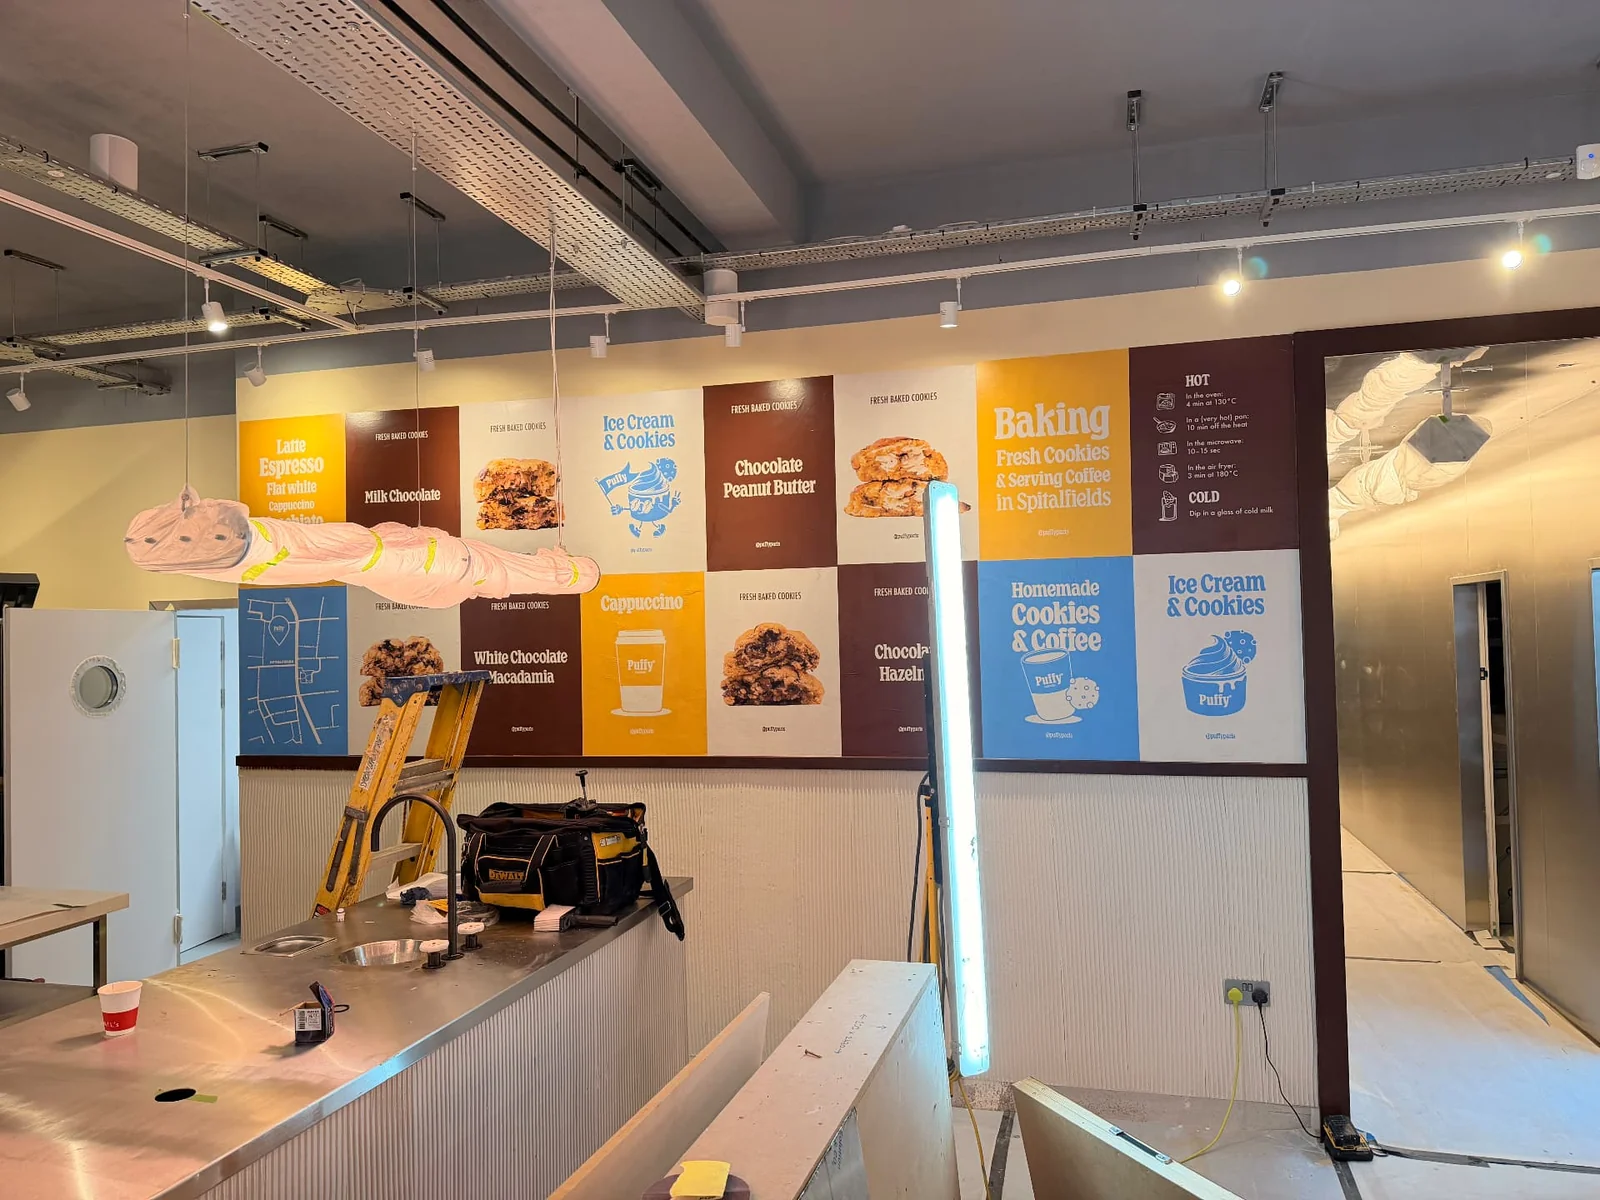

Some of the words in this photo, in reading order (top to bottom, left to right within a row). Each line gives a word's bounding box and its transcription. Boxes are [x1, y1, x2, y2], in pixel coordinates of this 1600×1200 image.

[1185, 373, 1211, 387] HOT
[870, 396, 889, 405] FRESH
[890, 394, 910, 404] BAKED
[911, 392, 938, 402] COOKIES
[1193, 392, 1204, 400] the
[731, 404, 750, 414] FRESH
[751, 402, 770, 413] BAKED
[772, 400, 798, 411] COOKIES
[490, 424, 506, 433] FRESH
[507, 423, 523, 432] BAKED
[524, 421, 547, 431] COOKIES
[603, 415, 625, 431] Ice
[627, 414, 675, 430] Cream
[994, 402, 1111, 440] Baking
[1210, 422, 1220, 430] off
[1233, 421, 1248, 429] heat
[375, 432, 390, 441] FRESH
[391, 431, 407, 440] BAKED
[407, 430, 429, 439] COOKIES
[604, 433, 614, 450] &
[617, 431, 676, 450] Cookies
[1206, 438, 1244, 446] microwave:
[276, 438, 307, 455] Latte
[996, 447, 1041, 467] Fresh
[1044, 444, 1110, 464] Cookies
[259, 456, 325, 480] Espresso
[735, 457, 803, 477] Chocolate
[996, 473, 1006, 488] &
[1008, 471, 1063, 488] Serving
[1065, 467, 1111, 485] Coffee
[266, 481, 286, 496] Flat
[287, 479, 317, 495] white
[723, 481, 772, 498] Peanut
[773, 479, 816, 496] Butter
[364, 490, 388, 504] Milk
[389, 488, 441, 503] Chocolate
[996, 493, 1014, 511] in
[1017, 488, 1112, 514] Spitalfields
[1188, 490, 1220, 504] COLD
[269, 499, 315, 513] Cappuccino
[1189, 510, 1201, 518] Dip
[1217, 509, 1234, 517] glass
[1244, 507, 1259, 515] cold
[1260, 506, 1274, 514] milk
[874, 588, 892, 597] FRESH
[893, 586, 913, 596] BAKED
[1011, 579, 1100, 598] Homemade
[1168, 575, 1197, 594] Ice
[1200, 573, 1266, 593] Cream
[600, 593, 684, 614] Cappuccino
[739, 593, 757, 601] FRESH
[758, 592, 777, 601] BAKED
[777, 591, 802, 600] COOKIES
[375, 602, 391, 610] FRESH
[491, 602, 508, 611] FRESH
[509, 601, 526, 610] BAKED
[527, 601, 550, 610] COOKIES
[1012, 601, 1101, 626] Cookies
[1166, 597, 1182, 617] &
[1184, 595, 1265, 617] Cookies
[1012, 629, 1028, 652] &
[1031, 627, 1102, 651] Coffee
[474, 650, 509, 665] White
[510, 649, 568, 665] Chocolate
[874, 643, 931, 660] Chocola
[489, 670, 555, 685] Macadamia
[879, 666, 924, 682] Hazeln
[1199, 694, 1231, 708] Puffy
